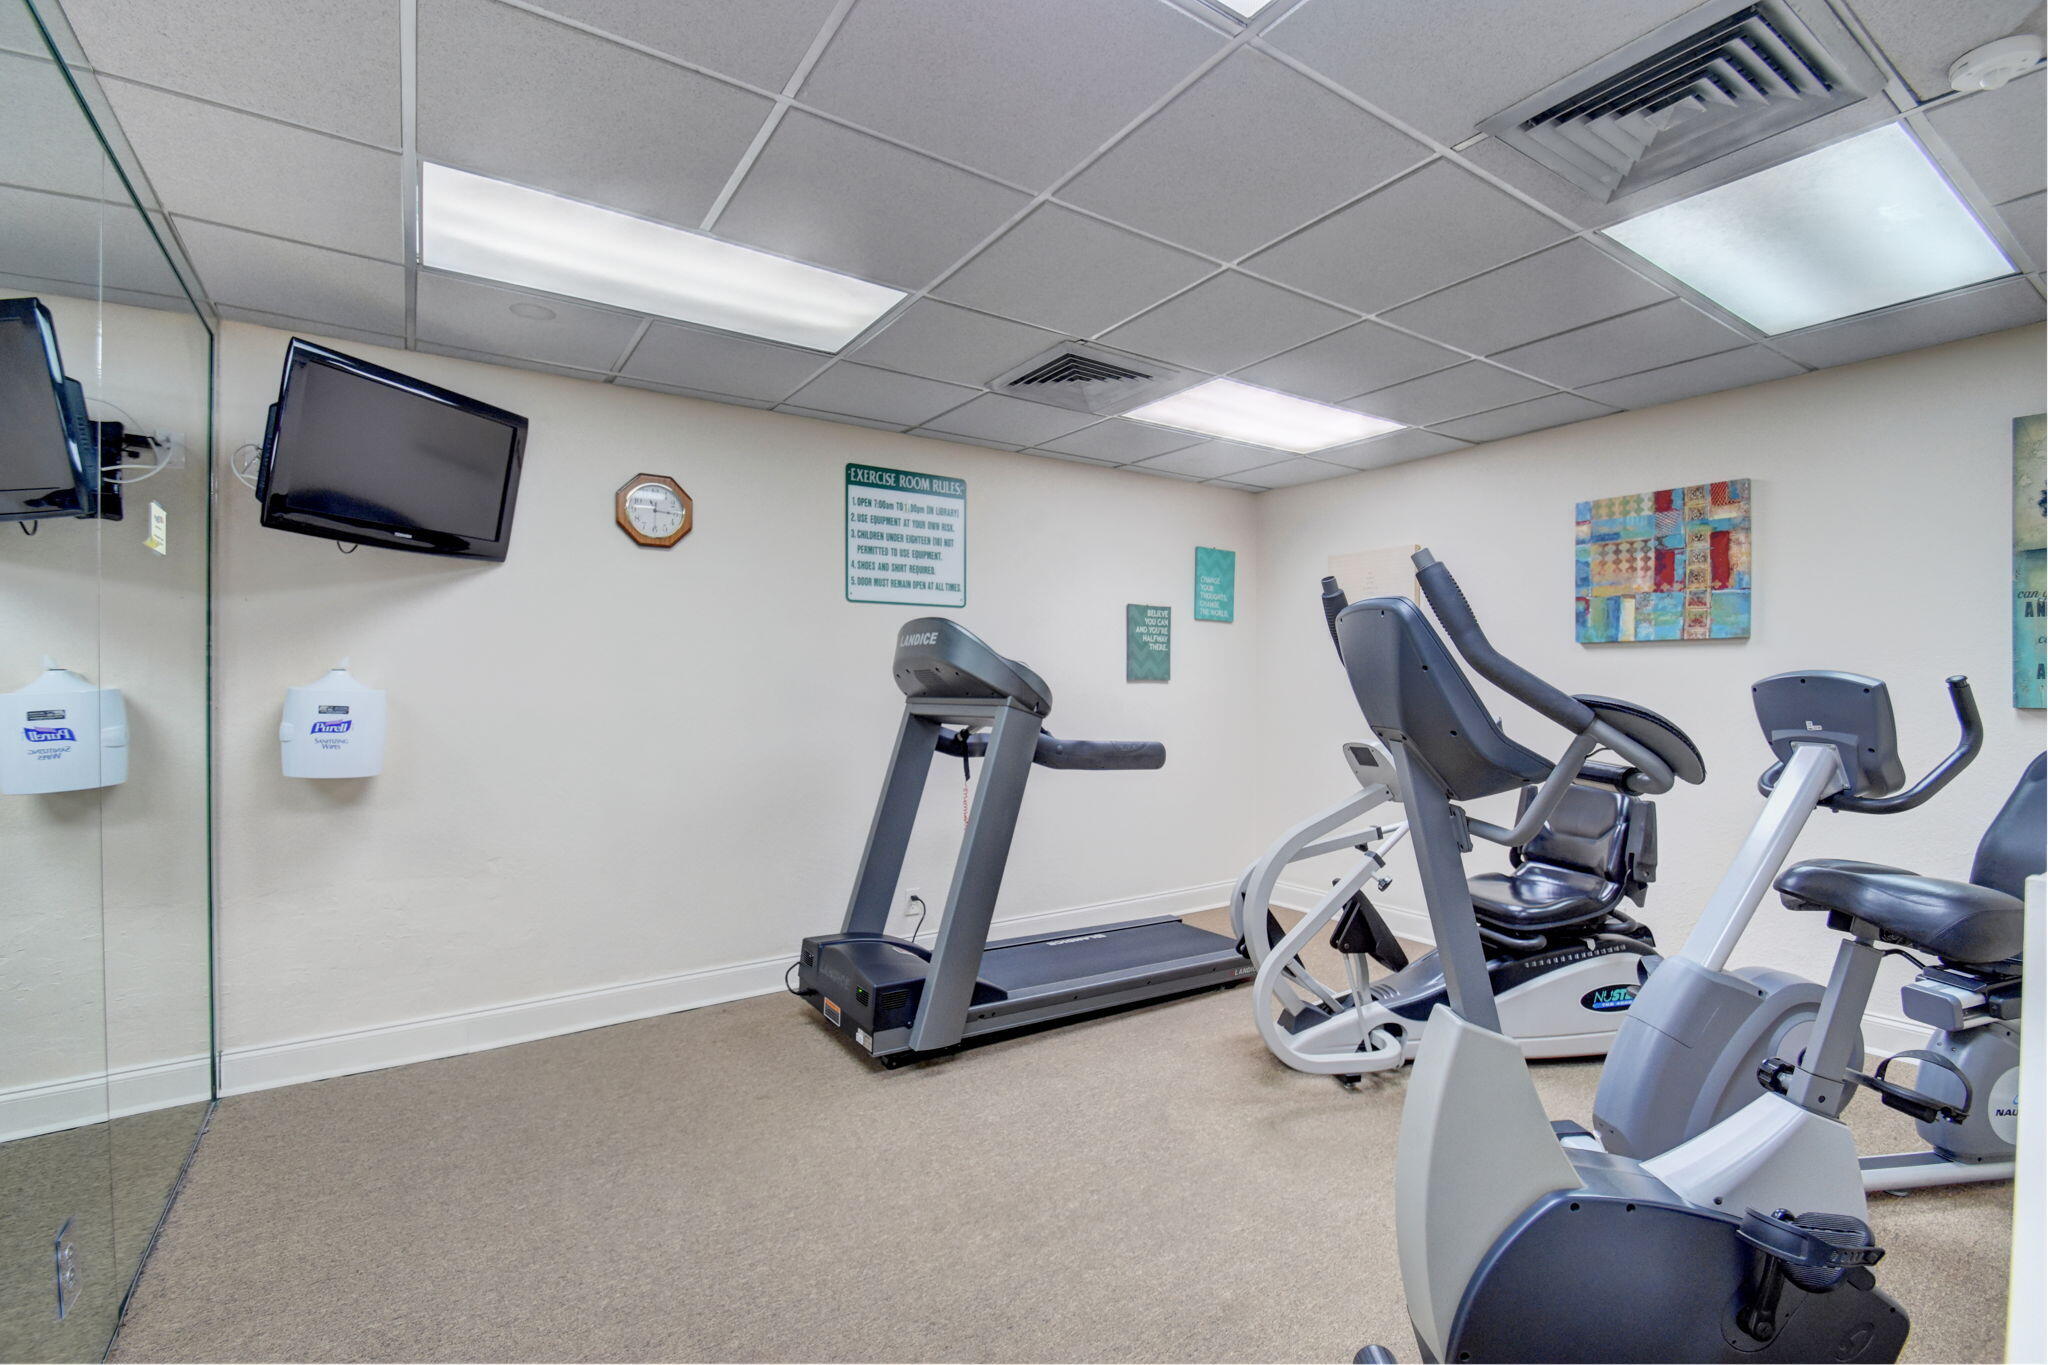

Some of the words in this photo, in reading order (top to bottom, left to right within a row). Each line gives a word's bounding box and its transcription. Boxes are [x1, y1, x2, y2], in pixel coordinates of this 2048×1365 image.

[850, 467, 896, 487] EXERCISE
[899, 475, 930, 491] ROOM
[857, 497, 872, 507] OPEN
[896, 502, 903, 512] TO
[857, 513, 869, 524] USE
[870, 515, 901, 527] EQUIPMENT
[903, 519, 910, 528] AT
[912, 519, 926, 530] YOUR
[927, 521, 940, 531] OWN
[857, 529, 884, 541] CHILDREN
[886, 532, 904, 543] UNDER
[905, 534, 931, 546] EIGHTEEN
[943, 538, 955, 548] NOT
[857, 544, 889, 557] PERMITTED
[891, 548, 898, 557] TO
[899, 548, 910, 558] USE
[911, 549, 942, 561] EQUIPMENT.
[857, 560, 875, 571] SHOES
[877, 562, 889, 572] AND
[891, 563, 907, 573] SHIRT
[857, 576, 872, 586] DOOR
[873, 577, 889, 588] MUST
[890, 578, 912, 589] REMAIN
[912, 580, 926, 590] OPEN
[927, 581, 934, 591] AT
[934, 582, 945, 592] ALL
[1147, 609, 1168, 618] BELIEVE
[1144, 617, 1157, 625] YOU
[1157, 618, 1168, 626] CAN
[900, 631, 939, 648] LANDICE
[1142, 634, 1168, 643] HALFWAY
[314, 722, 348, 733] Purell
